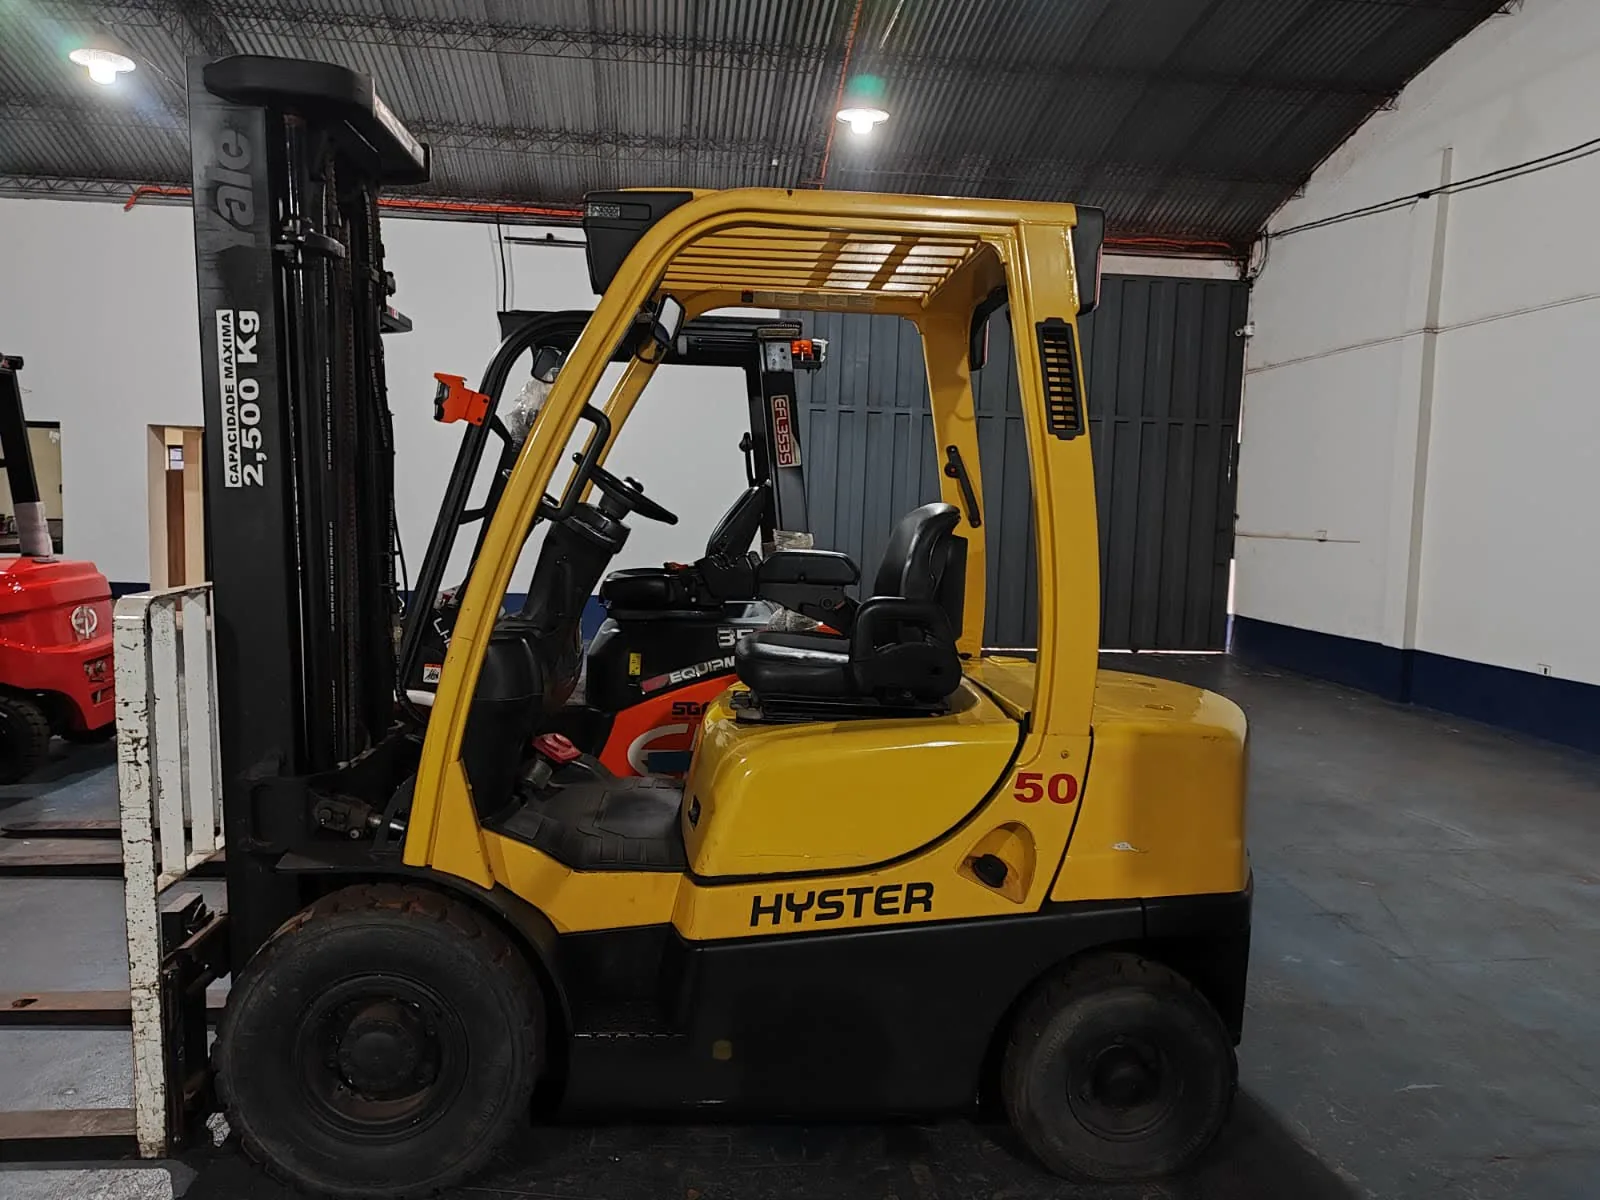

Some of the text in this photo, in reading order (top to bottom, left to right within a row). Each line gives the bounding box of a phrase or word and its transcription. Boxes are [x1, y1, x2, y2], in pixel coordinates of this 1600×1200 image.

[207, 127, 255, 250] Yale
[226, 385, 239, 485] CAPACIDADE
[238, 310, 267, 487] 2,500 Kg
[774, 398, 791, 465] EFL353S
[1013, 773, 1078, 804] 50
[750, 882, 934, 926] HYSTER
